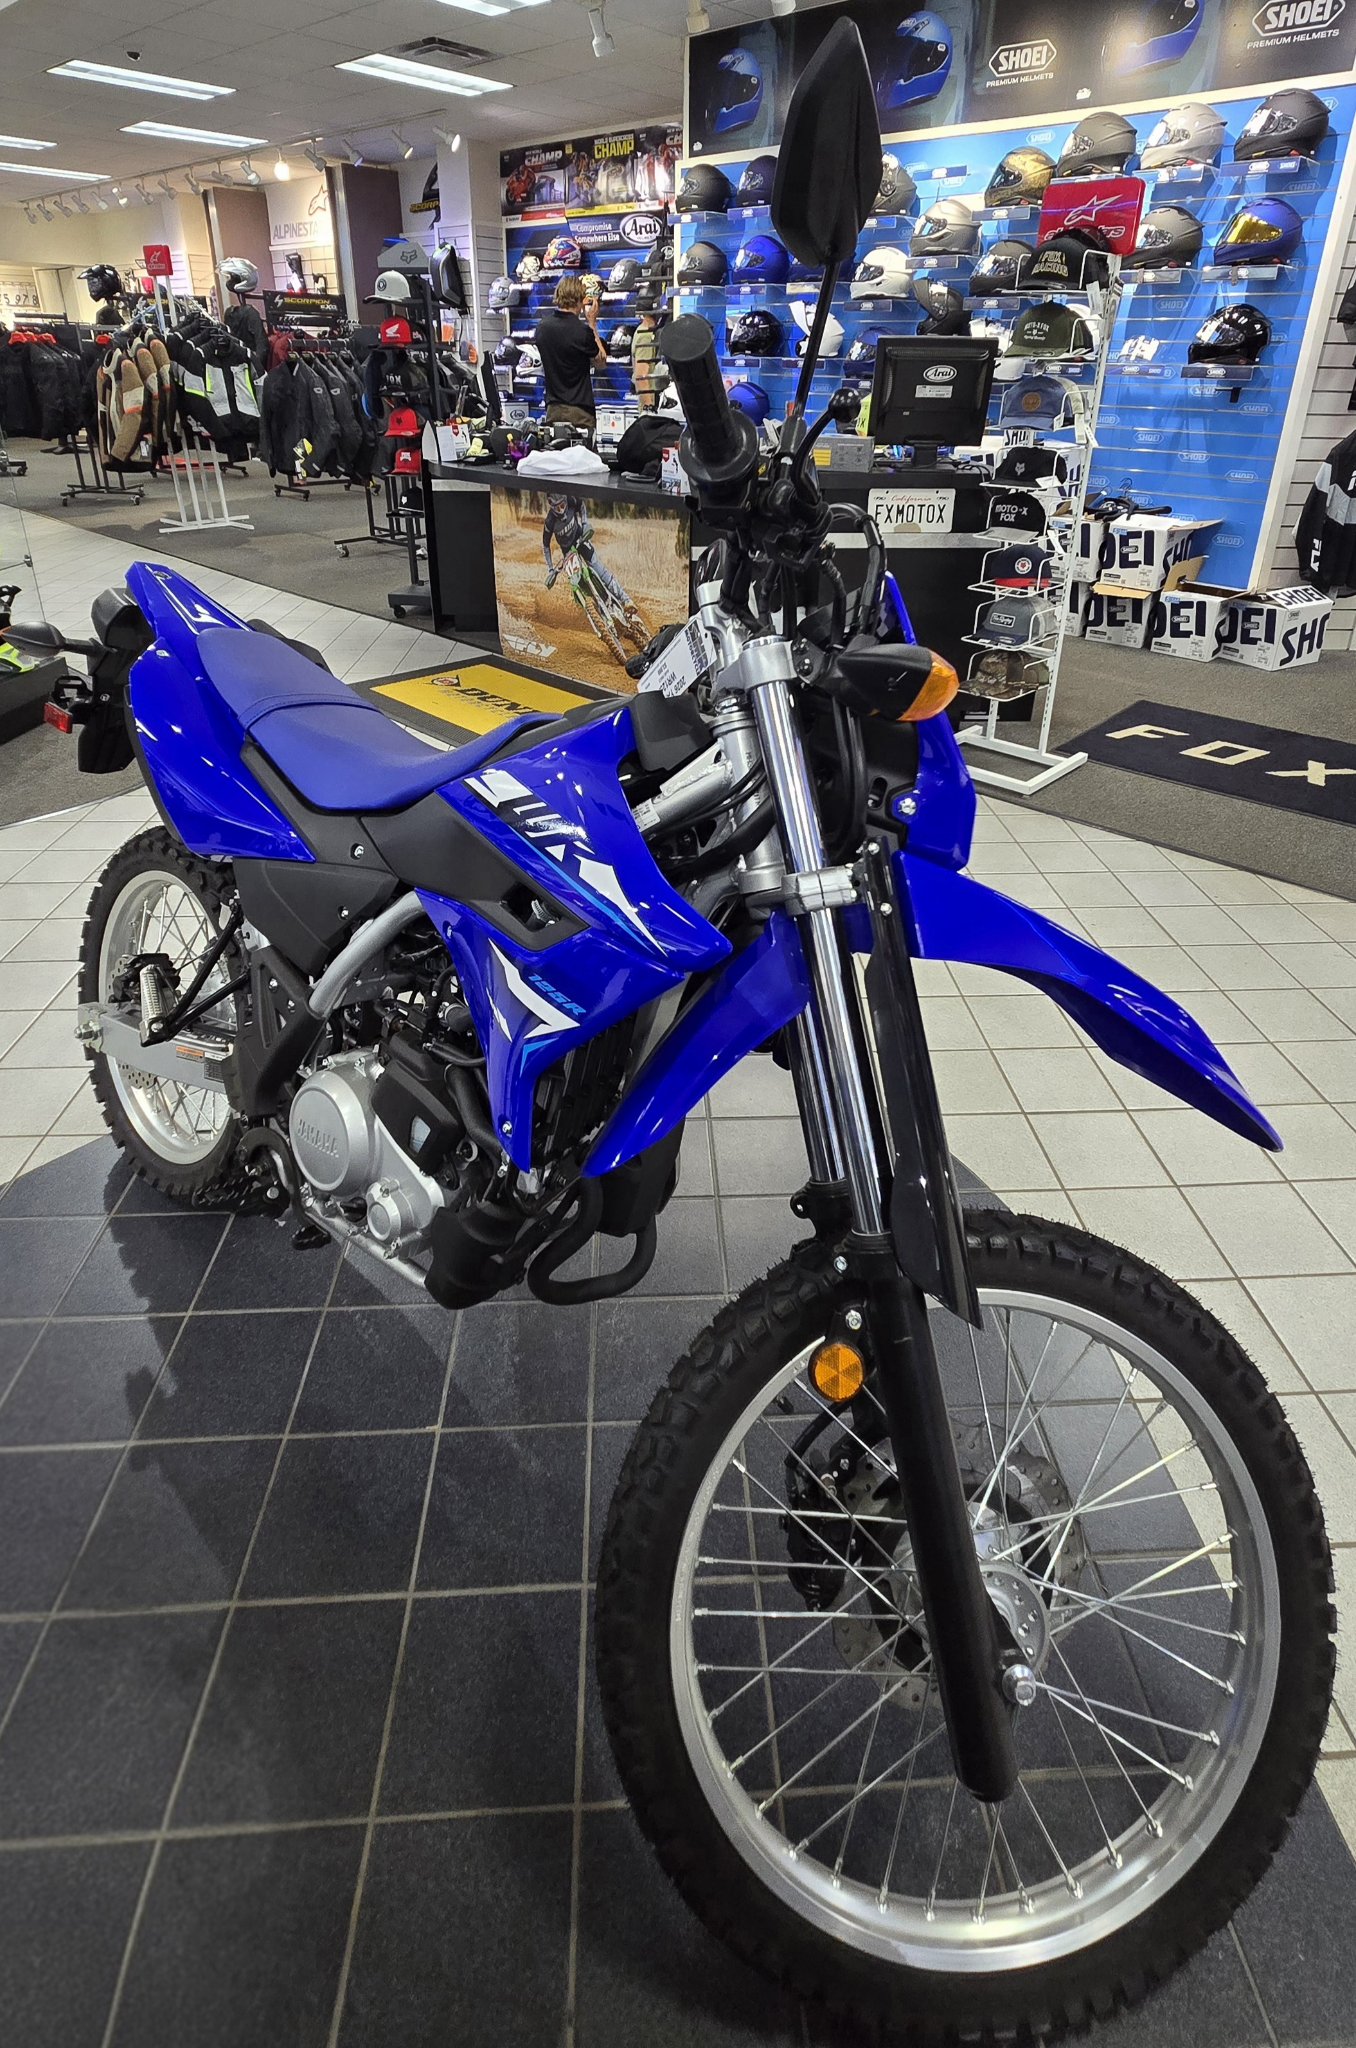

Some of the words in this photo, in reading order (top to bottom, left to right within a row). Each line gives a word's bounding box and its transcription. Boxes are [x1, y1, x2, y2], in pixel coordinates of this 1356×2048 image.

[1265, 0, 1331, 30] SHOEI
[1247, 36, 1291, 49] PREMIUM
[1293, 29, 1340, 42] HELMETS
[998, 46, 1048, 71] SHOEI
[986, 75, 1019, 88] PREMIUM
[1020, 73, 1054, 83] HELMETS
[525, 151, 563, 166] CHAMP
[594, 141, 634, 159] CHAMP
[273, 221, 318, 239] ALPINESTA
[576, 222, 612, 234] Compromise
[627, 219, 661, 236] Arai
[574, 233, 606, 243] Somewhere
[607, 232, 620, 242] Else
[284, 297, 331, 305] SCORPION
[929, 368, 952, 378] Arai
[1137, 433, 1161, 442] SHOEI
[891, 494, 932, 505] California
[875, 504, 946, 524] FXMOTOX
[999, 513, 1016, 522] FOX
[1216, 536, 1241, 545] SHOEI
[1310, 538, 1322, 572] FLY
[1273, 587, 1328, 606] SHOEI
[455, 688, 541, 715] DUN
[1105, 724, 1356, 787] FOX
